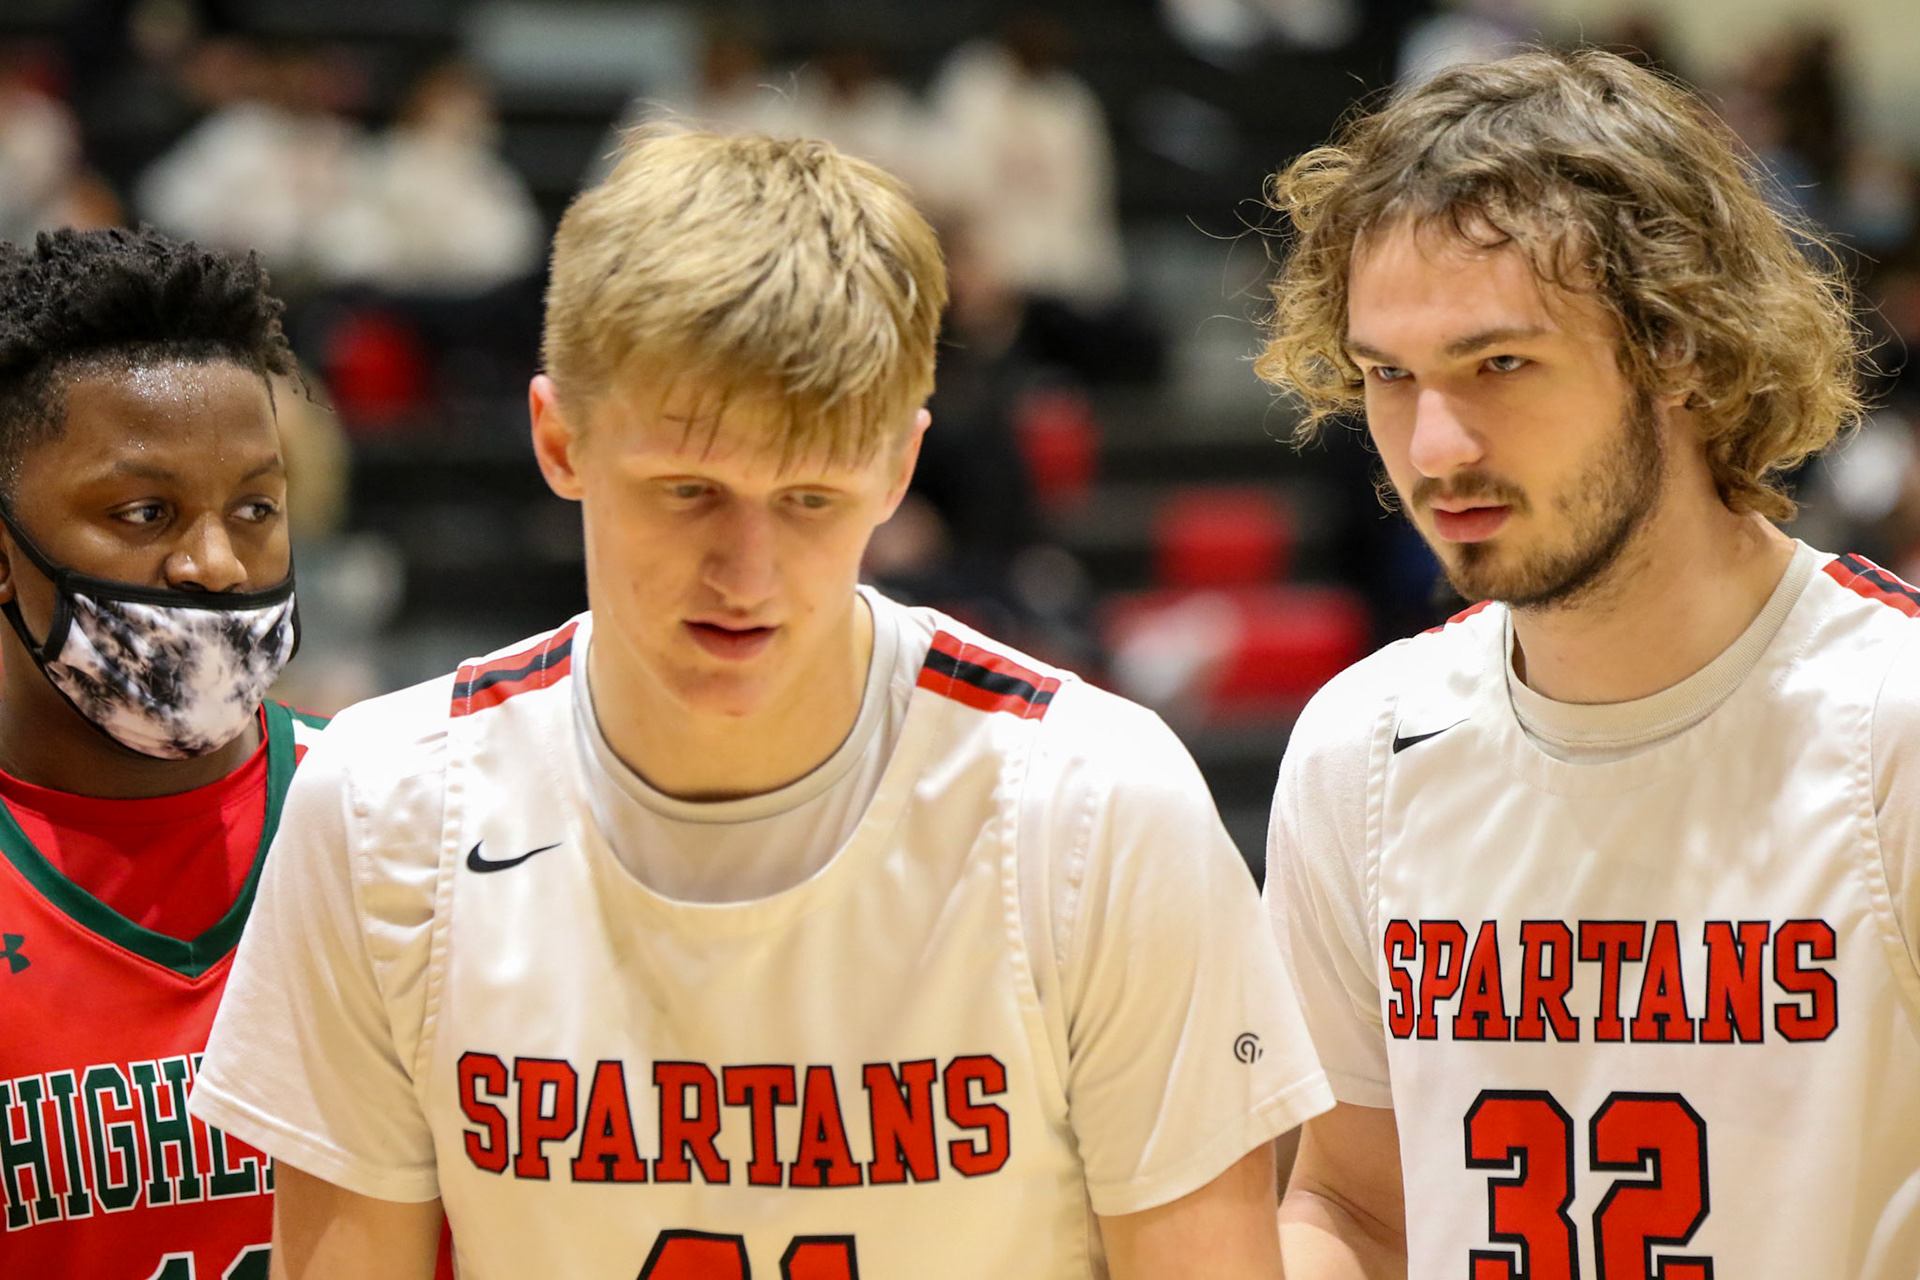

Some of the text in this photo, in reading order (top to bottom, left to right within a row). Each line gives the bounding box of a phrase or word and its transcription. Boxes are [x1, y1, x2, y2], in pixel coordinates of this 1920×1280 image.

[1384, 919, 1838, 1043] SPARTANS
[457, 1051, 1011, 1188] SPARTANS
[1463, 1090, 1714, 1280] 32
